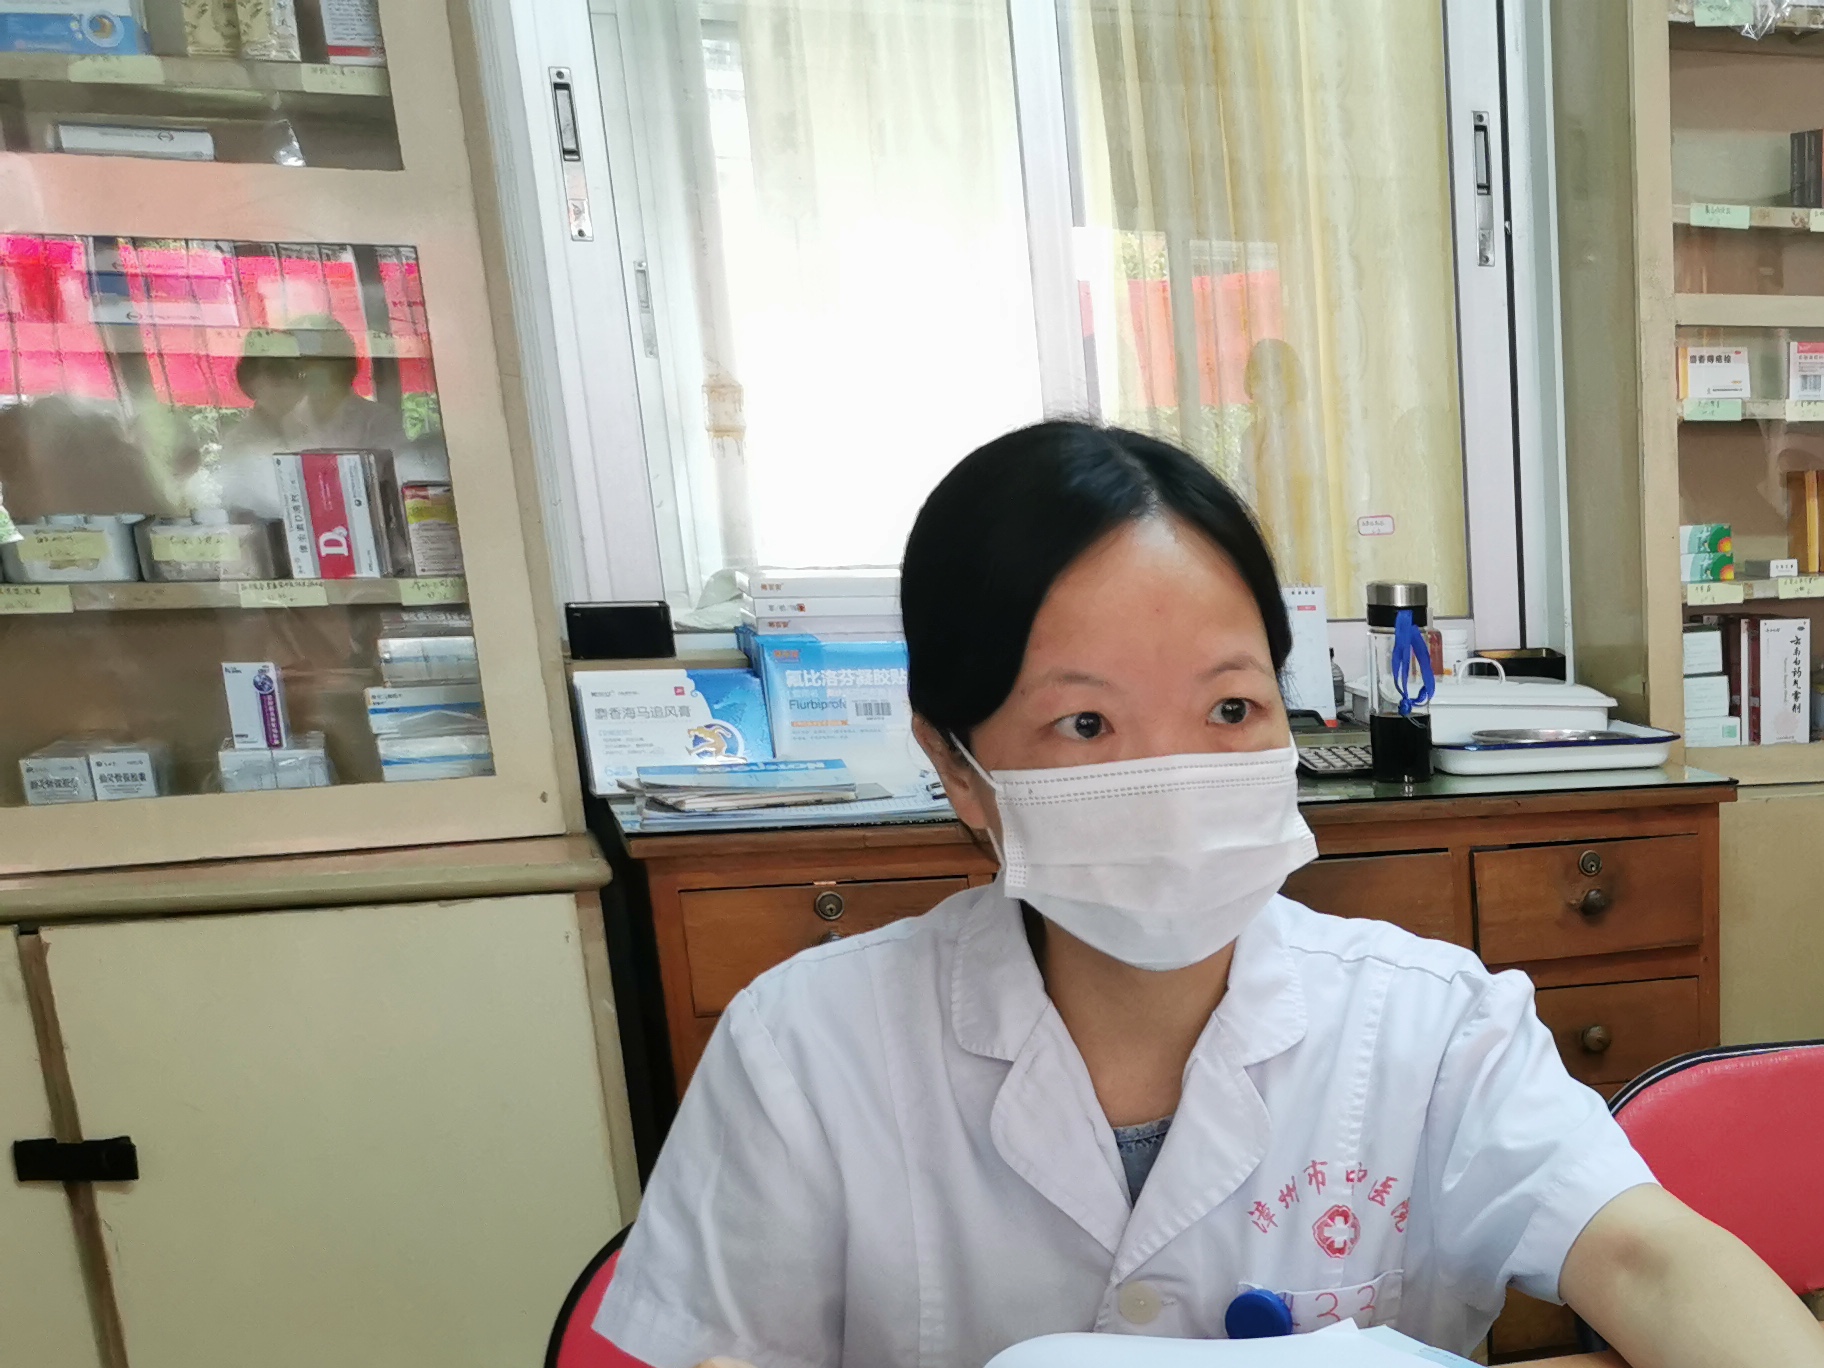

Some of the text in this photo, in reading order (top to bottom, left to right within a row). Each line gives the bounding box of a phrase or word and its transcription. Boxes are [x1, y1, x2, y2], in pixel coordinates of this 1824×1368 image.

[1790, 635, 1802, 713] 云南白药气雾剂
[594, 705, 692, 720] 麝香海马追风膏
